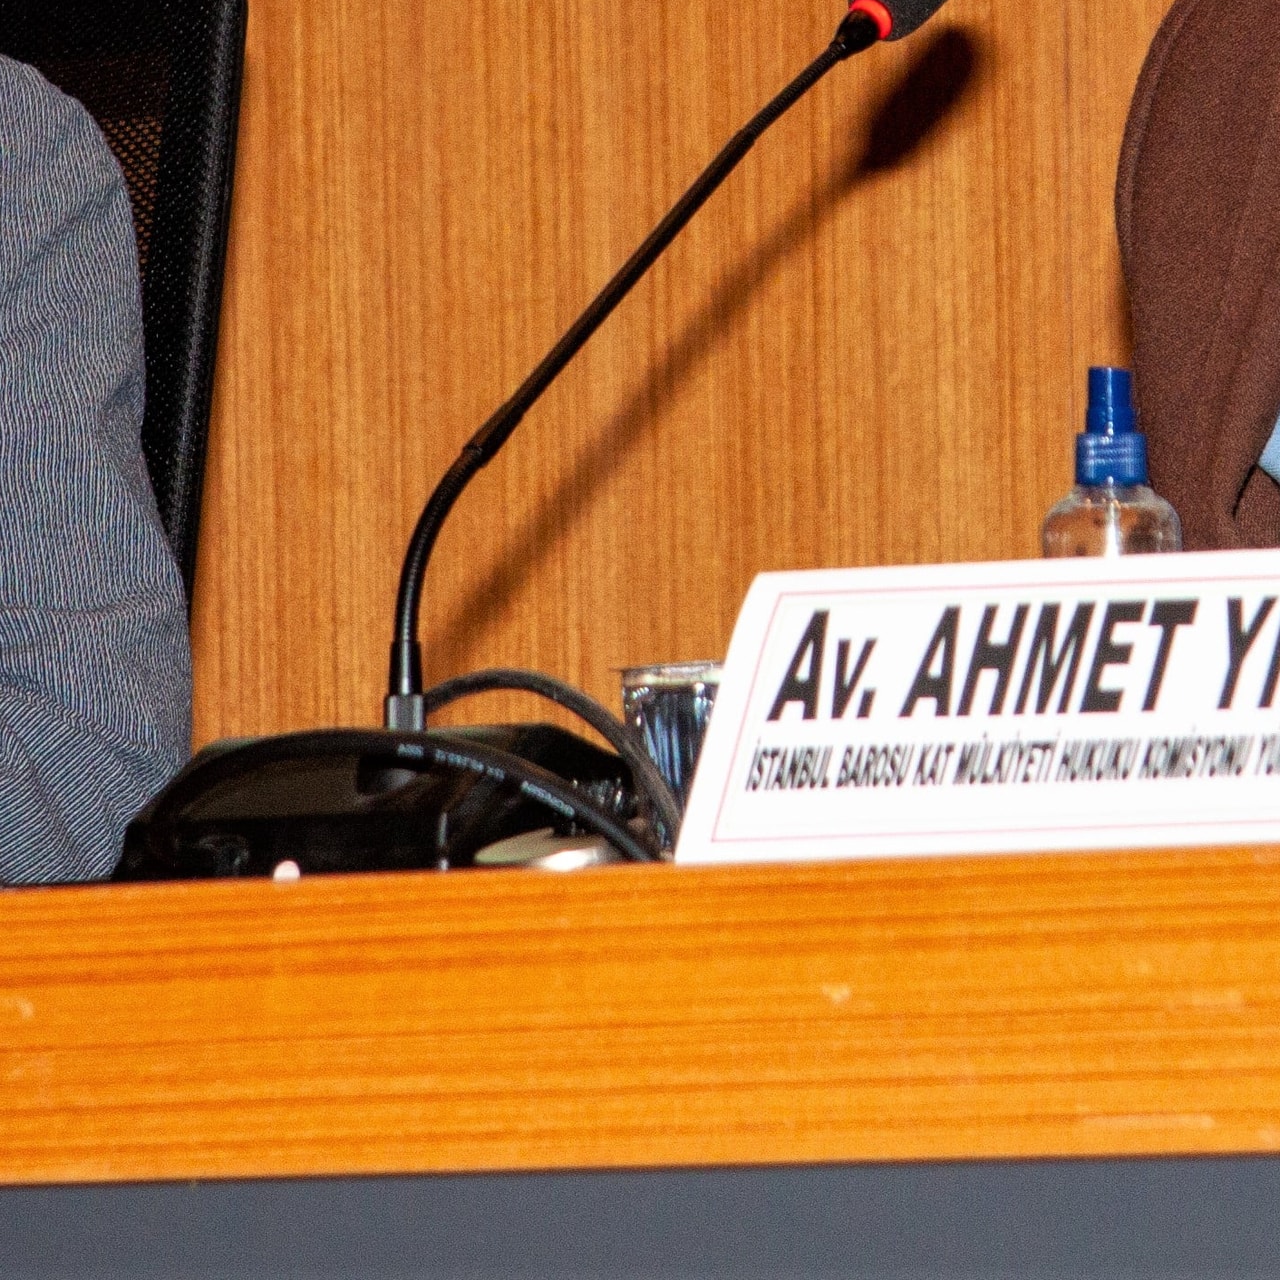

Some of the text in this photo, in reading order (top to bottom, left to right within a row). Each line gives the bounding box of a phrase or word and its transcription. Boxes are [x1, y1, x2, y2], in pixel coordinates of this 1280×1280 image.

[898, 598, 1200, 719] AHMET
[745, 736, 833, 792] İSTANBUL
[835, 743, 914, 789] BAROSU
[912, 742, 955, 786] KAT
[952, 729, 1061, 785] MÜLKİYETİ
[1055, 737, 1141, 783] HUKUKU
[1138, 724, 1254, 781] KOMİSYONU
